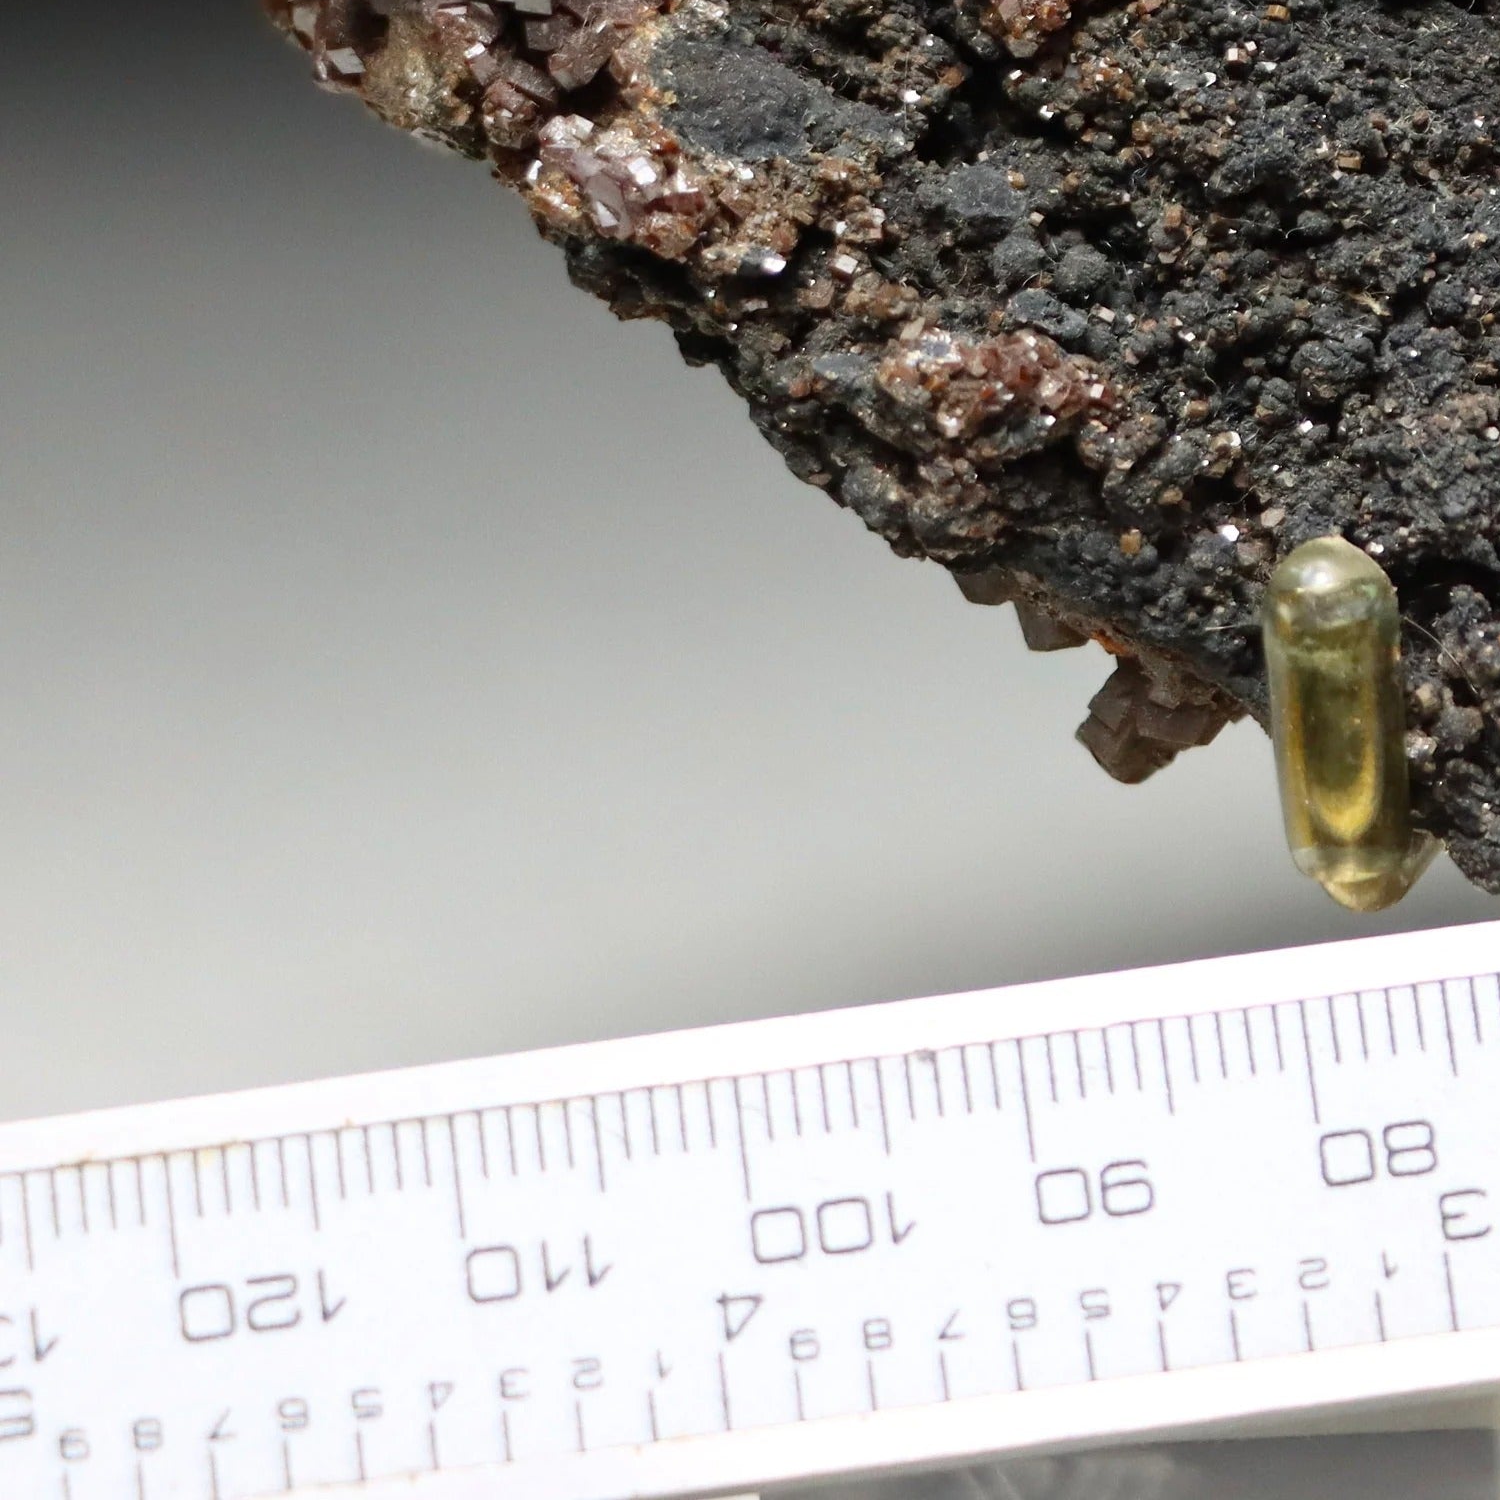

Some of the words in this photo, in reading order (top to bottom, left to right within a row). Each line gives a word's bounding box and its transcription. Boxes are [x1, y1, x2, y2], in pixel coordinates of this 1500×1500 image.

[1319, 1119, 1438, 1187] 80
[1035, 1160, 1155, 1224] 90
[750, 1191, 916, 1264] 100
[1439, 1189, 1492, 1241] 3
[466, 1234, 612, 1303] 110
[1299, 1258, 1329, 1290] 2
[1381, 1249, 1399, 1281] 1
[1155, 1282, 1182, 1311] 4
[1226, 1268, 1257, 1301] 3
[179, 1269, 346, 1342] 120
[718, 1292, 764, 1342] 4
[1006, 1298, 1038, 1331] 6
[1080, 1289, 1111, 1320] 5
[0, 1306, 59, 1364] 1
[862, 1318, 893, 1351] 8
[938, 1312, 963, 1341] 7
[789, 1329, 820, 1362] 9
[573, 1358, 602, 1390] 2
[654, 1349, 674, 1380] 1
[428, 1382, 453, 1411] 4
[499, 1368, 526, 1399] 3
[277, 1398, 309, 1430] 6
[351, 1388, 382, 1420] 5
[132, 1418, 162, 1451] 8
[208, 1411, 232, 1441] 7
[58, 1428, 89, 1460] 9
